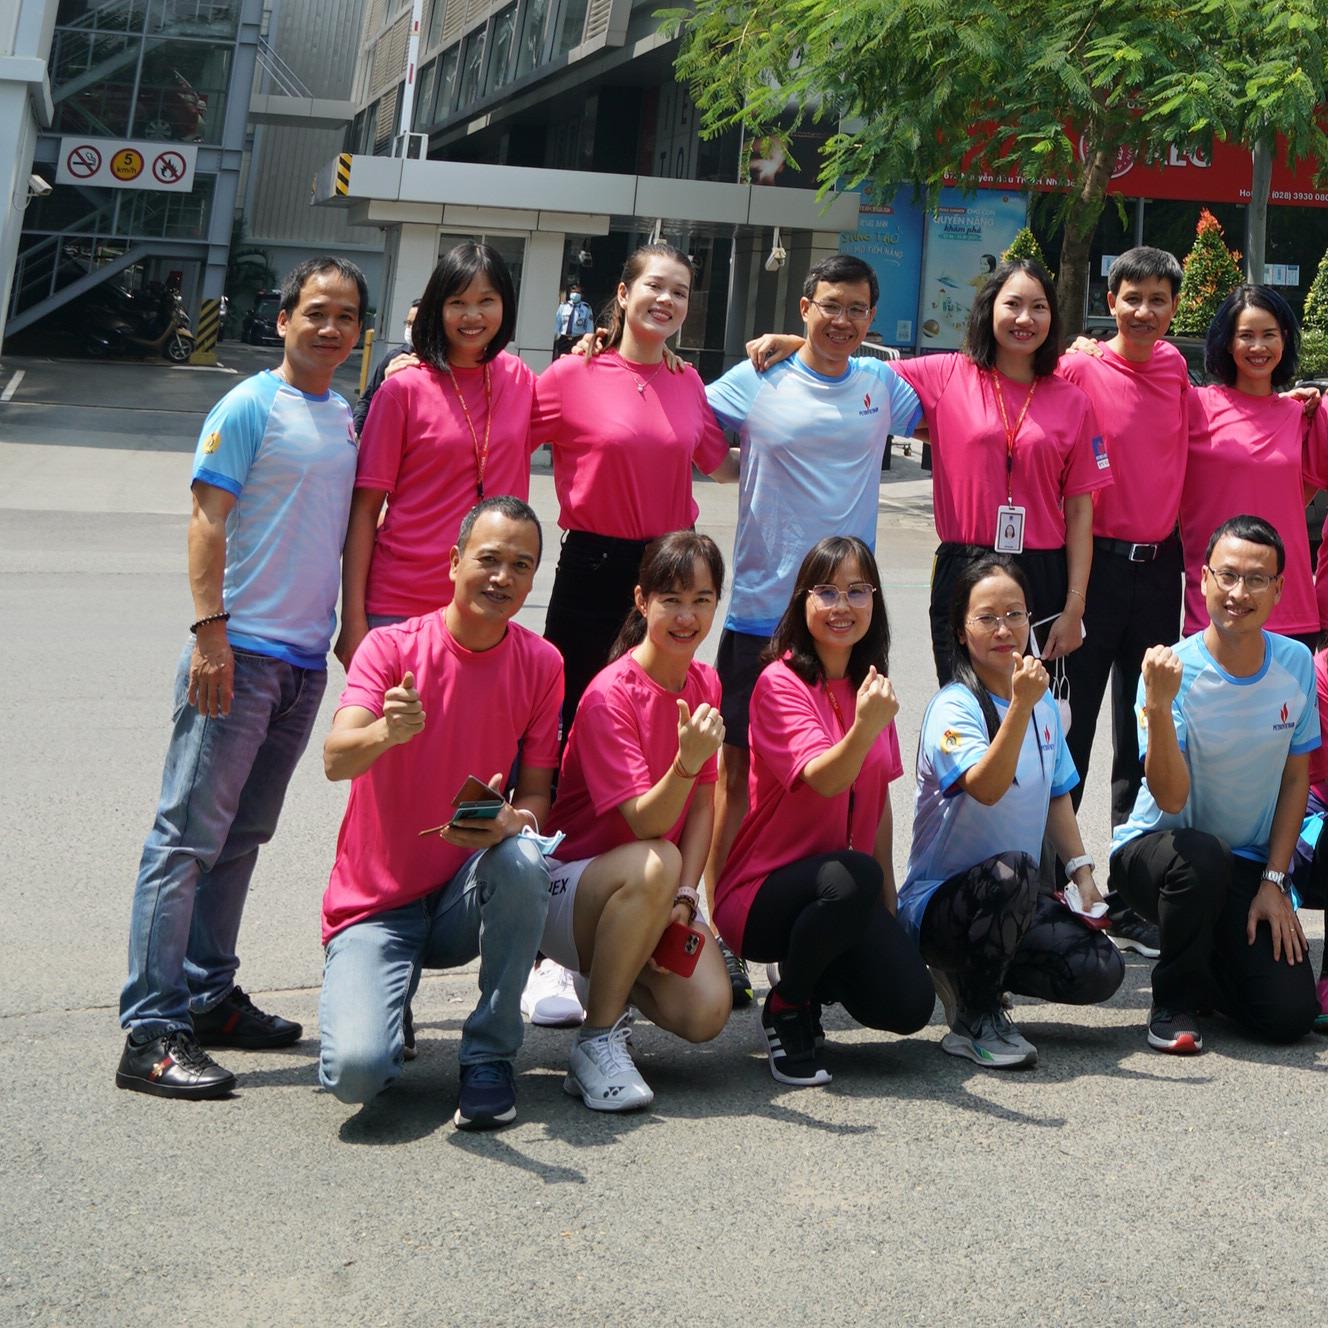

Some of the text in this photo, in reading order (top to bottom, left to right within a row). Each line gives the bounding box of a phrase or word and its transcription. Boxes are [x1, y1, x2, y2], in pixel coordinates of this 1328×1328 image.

[124, 153, 133, 165] 5
[1271, 191, 1292, 201] (028)
[1293, 192, 1313, 201] 3930
